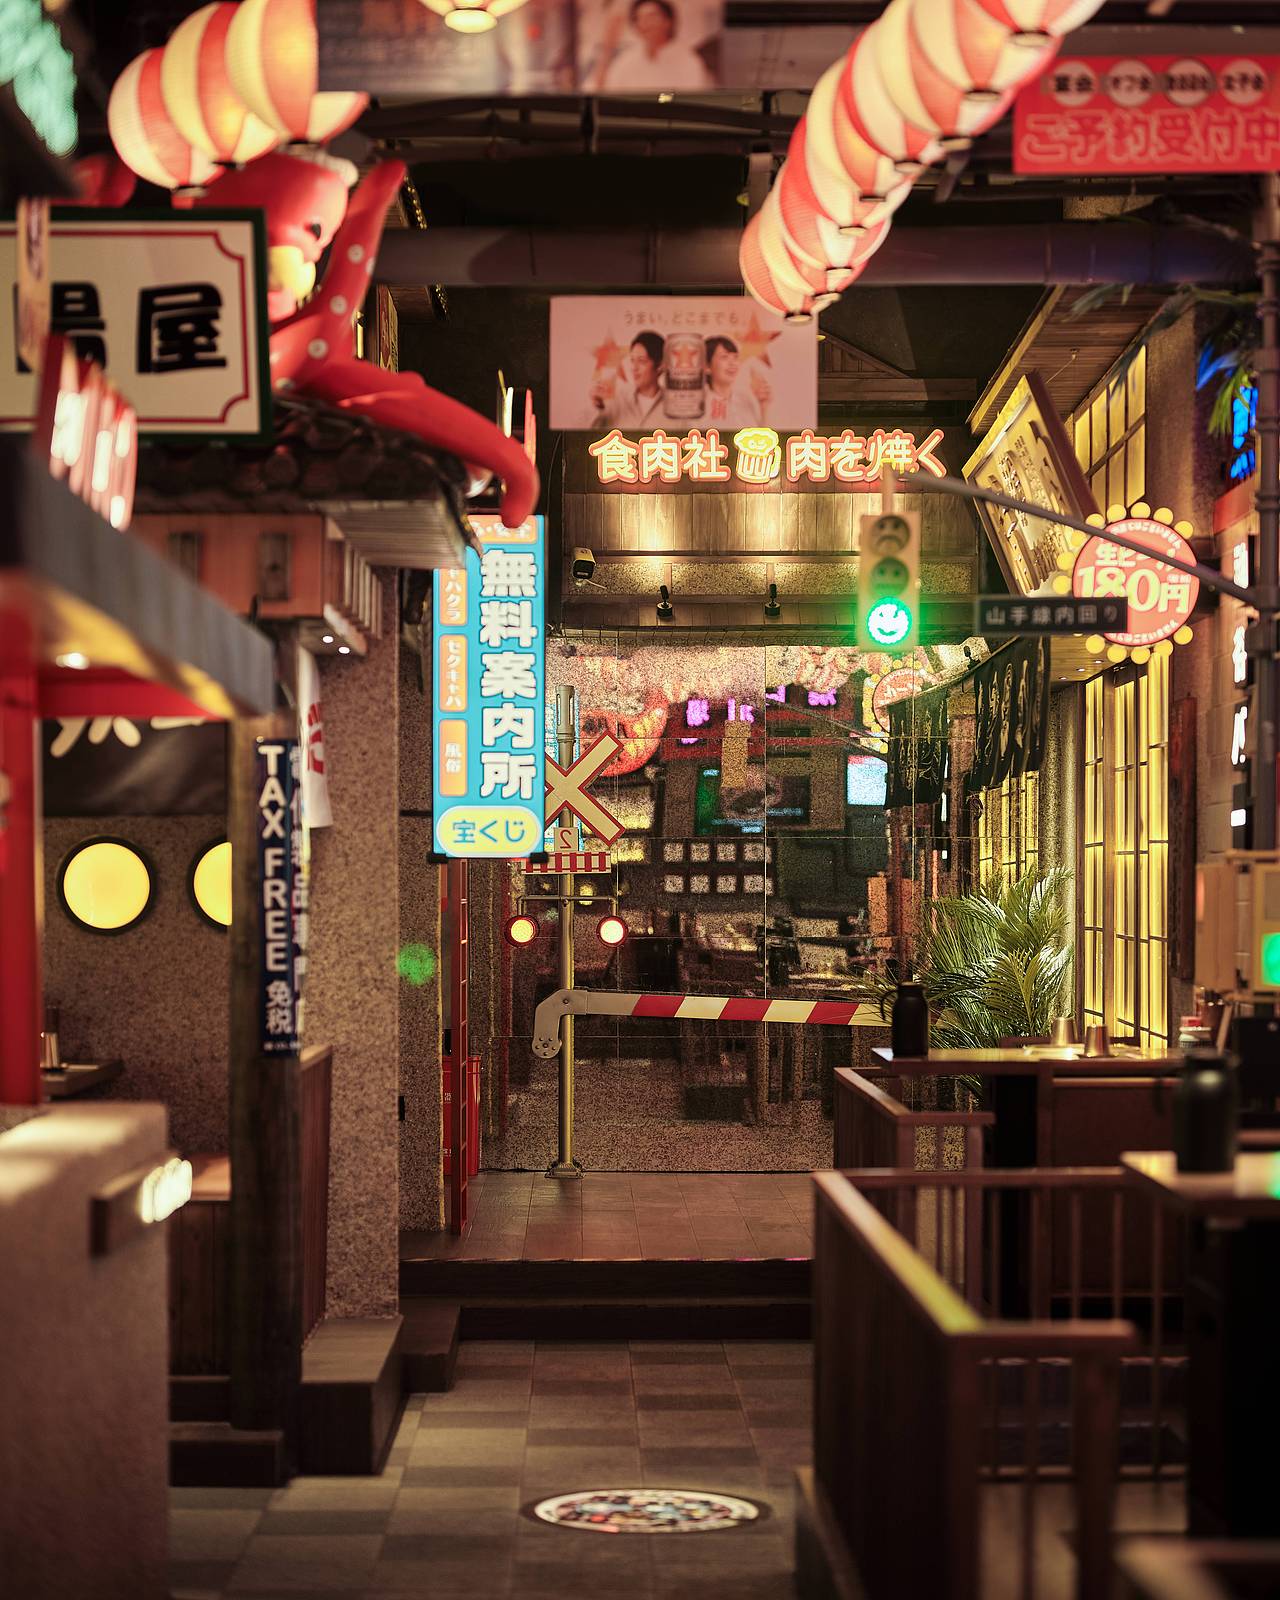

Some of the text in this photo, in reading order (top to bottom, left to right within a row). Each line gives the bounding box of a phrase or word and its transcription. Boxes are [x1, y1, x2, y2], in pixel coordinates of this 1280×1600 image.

[1021, 108, 1280, 166] ご予約受付中
[590, 430, 947, 483] 食肉社 肉を焼く
[1077, 565, 1190, 614] 180円
[479, 548, 539, 801] 無料案内所
[258, 745, 287, 839] TAX
[452, 819, 526, 845] 宝くじ
[263, 847, 288, 973] FREE
